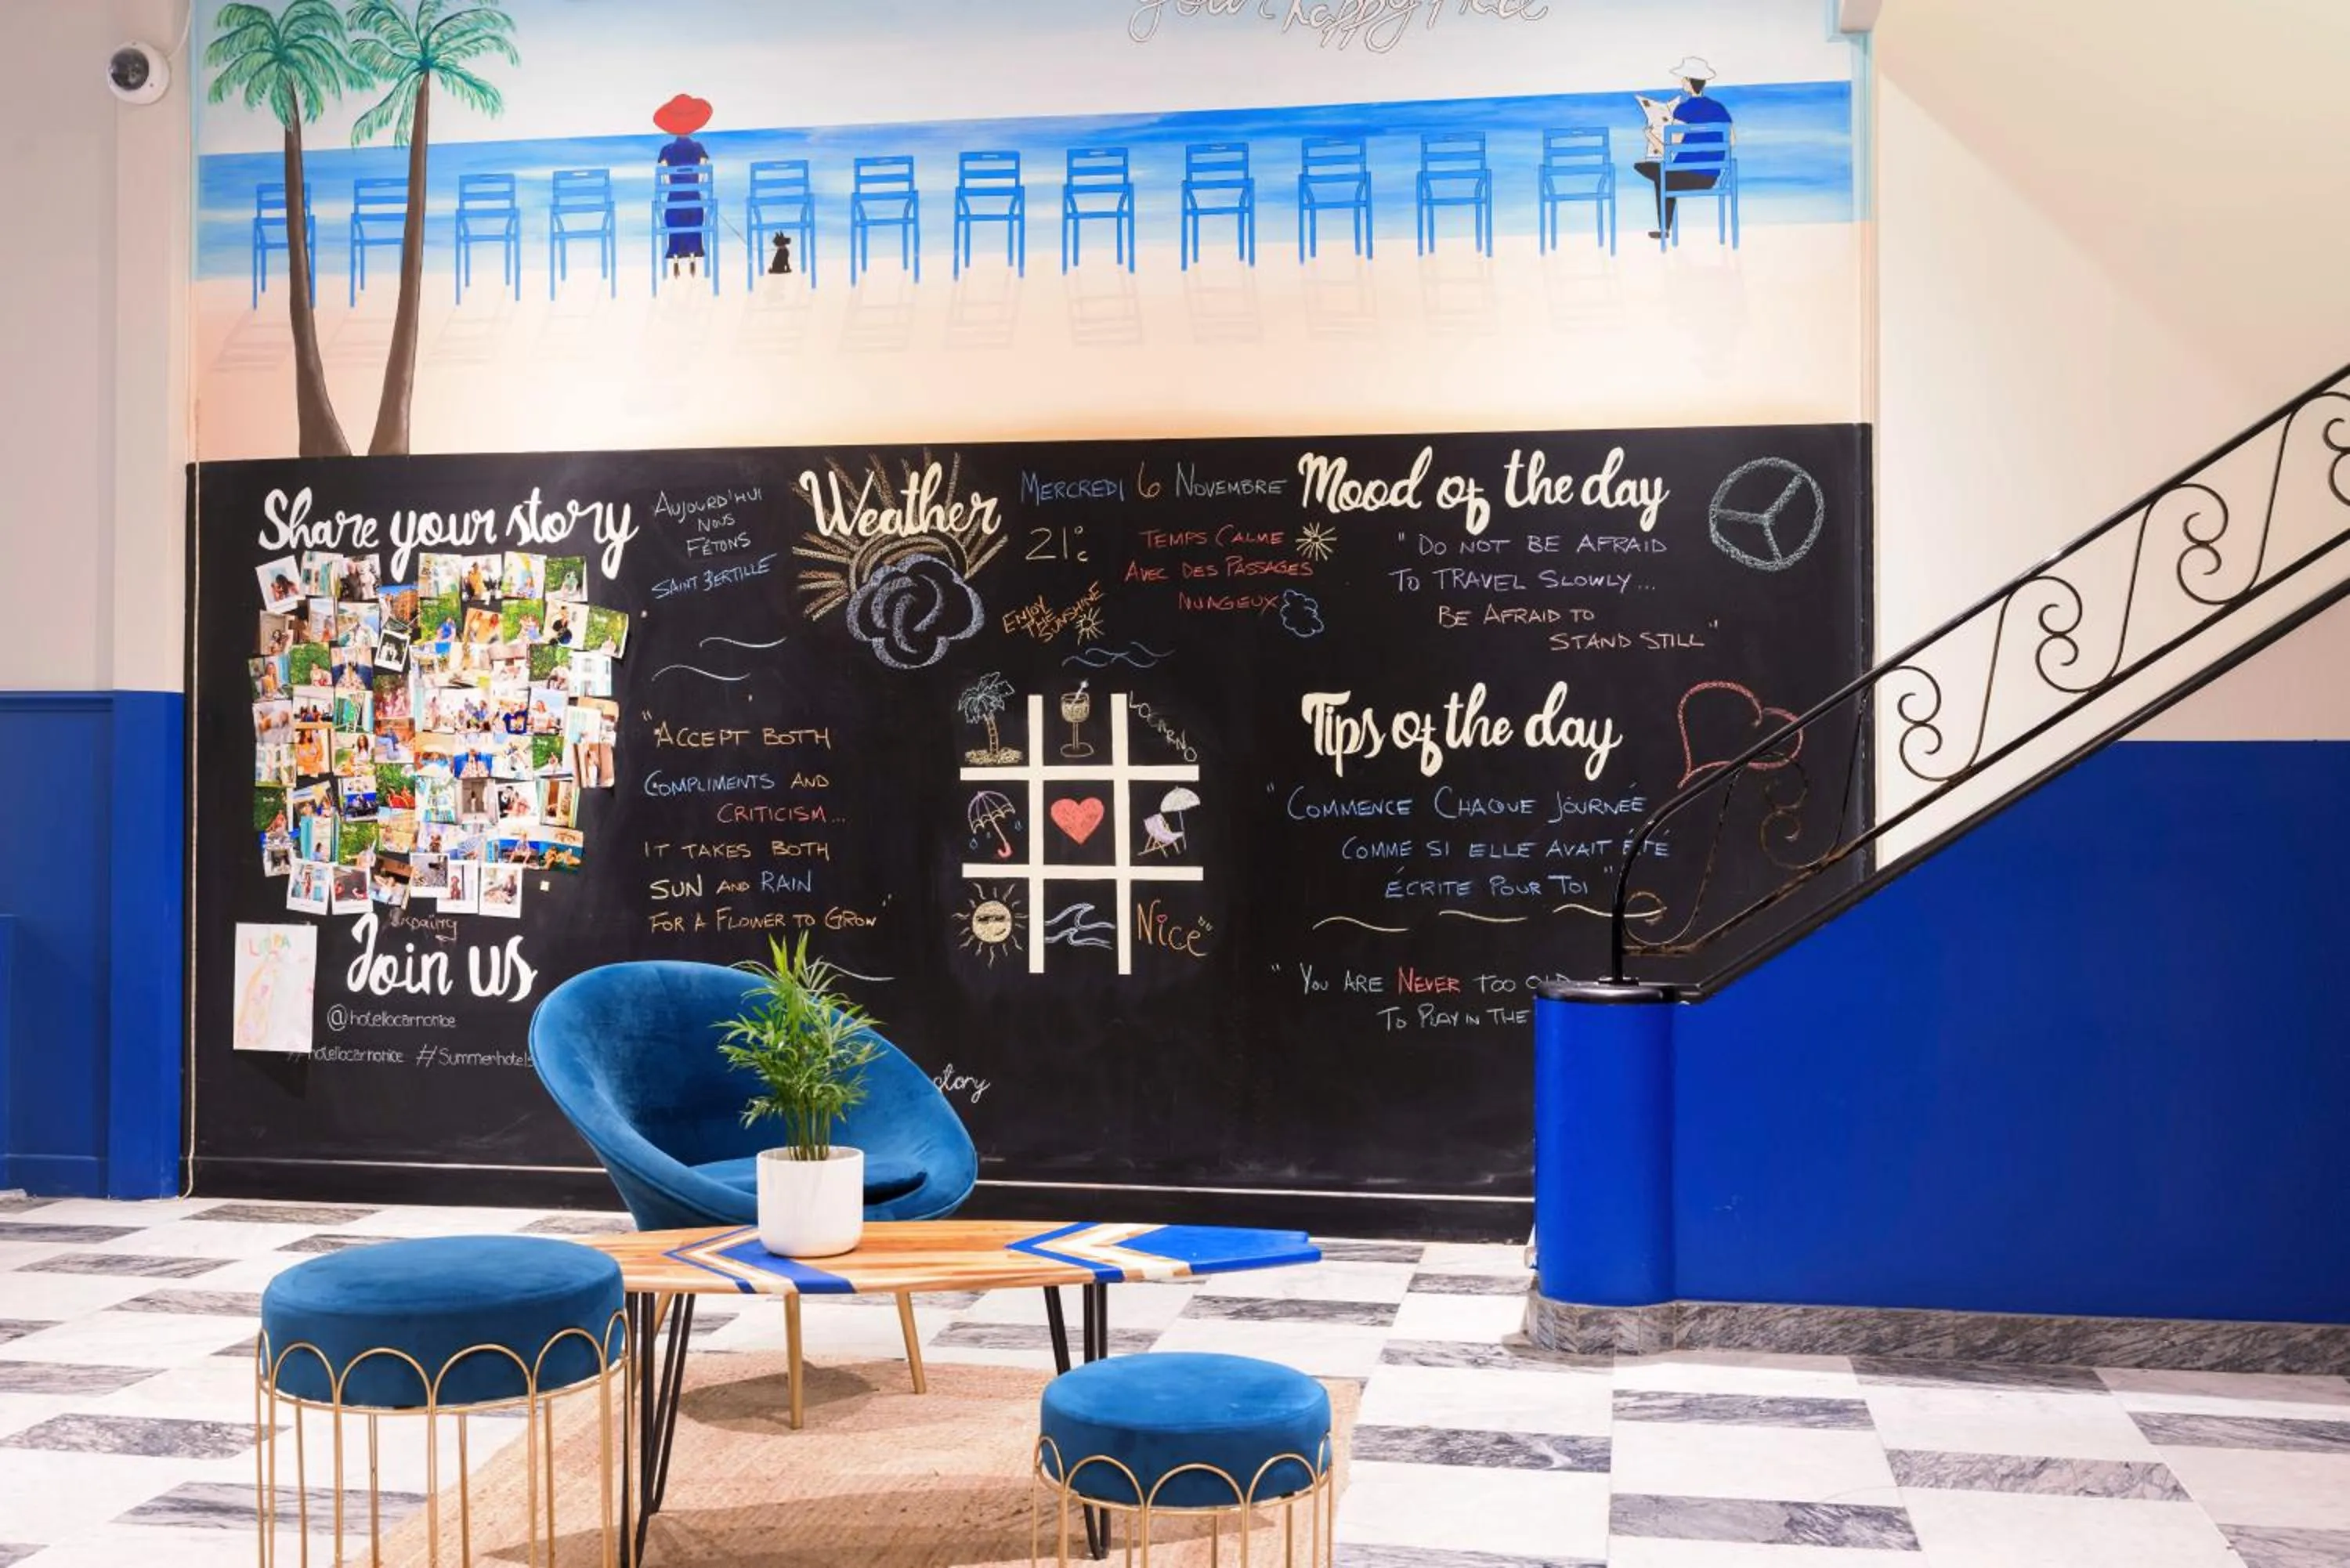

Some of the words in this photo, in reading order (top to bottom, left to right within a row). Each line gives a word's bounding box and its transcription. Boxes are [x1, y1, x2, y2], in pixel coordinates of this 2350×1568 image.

[1021, 471, 1125, 506] MERCREDI
[1137, 461, 1161, 499] 6
[1176, 461, 1288, 498] NOVEMBRE
[1297, 446, 1433, 514] Mood
[1436, 475, 1491, 536] of
[1503, 449, 1574, 508] the
[1580, 446, 1670, 532] day
[653, 487, 762, 526] AUJOURD'HUI
[800, 464, 1001, 537] Weather
[258, 486, 380, 551] Share
[389, 508, 497, 581] your
[506, 486, 641, 580] story
[697, 513, 736, 532] NOUS
[1141, 529, 1208, 548] TEMPS
[1215, 524, 1285, 546] CALME
[1419, 533, 1447, 556] DO
[1459, 540, 1511, 554] NOT
[1528, 535, 1560, 553] BE
[1576, 533, 1668, 553] AFRAID
[651, 576, 698, 599] SAINT
[702, 551, 777, 591] BERTILLE
[1125, 560, 1168, 582] AVEC
[1182, 562, 1219, 578] DES
[1225, 554, 1317, 576] PASSAGES
[1389, 568, 1420, 592] TO
[1432, 568, 1527, 591] TRAVEL
[1002, 594, 1049, 634] ENJOY
[1038, 580, 1105, 643] SUNSHINE
[1179, 591, 1279, 612] NUAGEUX
[1439, 605, 1470, 628] BE
[1483, 603, 1561, 624] AFRAID
[1569, 609, 1595, 623] TO
[1021, 607, 1058, 638] THE
[1549, 632, 1632, 651] STAND
[762, 727, 831, 750] BOTH
[1129, 691, 1198, 763] LOCARNO
[1301, 690, 1386, 778] Tips
[1391, 710, 1444, 778] of
[1443, 682, 1514, 749] the
[1524, 681, 1623, 782] day
[644, 770, 775, 797] COMPLIMENTS
[790, 772, 830, 789] AND
[1287, 786, 1413, 820] COMMENCE
[1434, 786, 1536, 818] CHAQUE
[645, 841, 671, 857] IT
[681, 844, 751, 859] TAKES
[772, 840, 830, 862] BOTH
[1342, 836, 1412, 859] COMME
[1426, 840, 1449, 857] SI
[1469, 842, 1536, 859] ELLE
[1546, 839, 1613, 857] AVAIT
[649, 873, 703, 900] SUN
[716, 880, 750, 894] AND
[761, 870, 812, 893] RAIN
[1385, 866, 1473, 898] ÉCRITE
[1489, 875, 1542, 896] POUR
[1547, 874, 1588, 894] TOI
[649, 911, 685, 933] FOR
[692, 910, 707, 930] A
[716, 906, 786, 930] FLOWER
[792, 914, 815, 928] TO
[1137, 899, 1207, 957] Nice
[347, 912, 454, 995] Join
[469, 934, 538, 1003] us
[1300, 962, 1329, 995] YOU
[1343, 970, 1383, 992] ARE
[1398, 967, 1461, 994] NEVER
[1475, 974, 1517, 993] TOO
[1377, 1006, 1408, 1031] TO
[1417, 1002, 1459, 1028] PLAY
[1466, 1014, 1480, 1025] IN
[1486, 1007, 1530, 1024] THE
